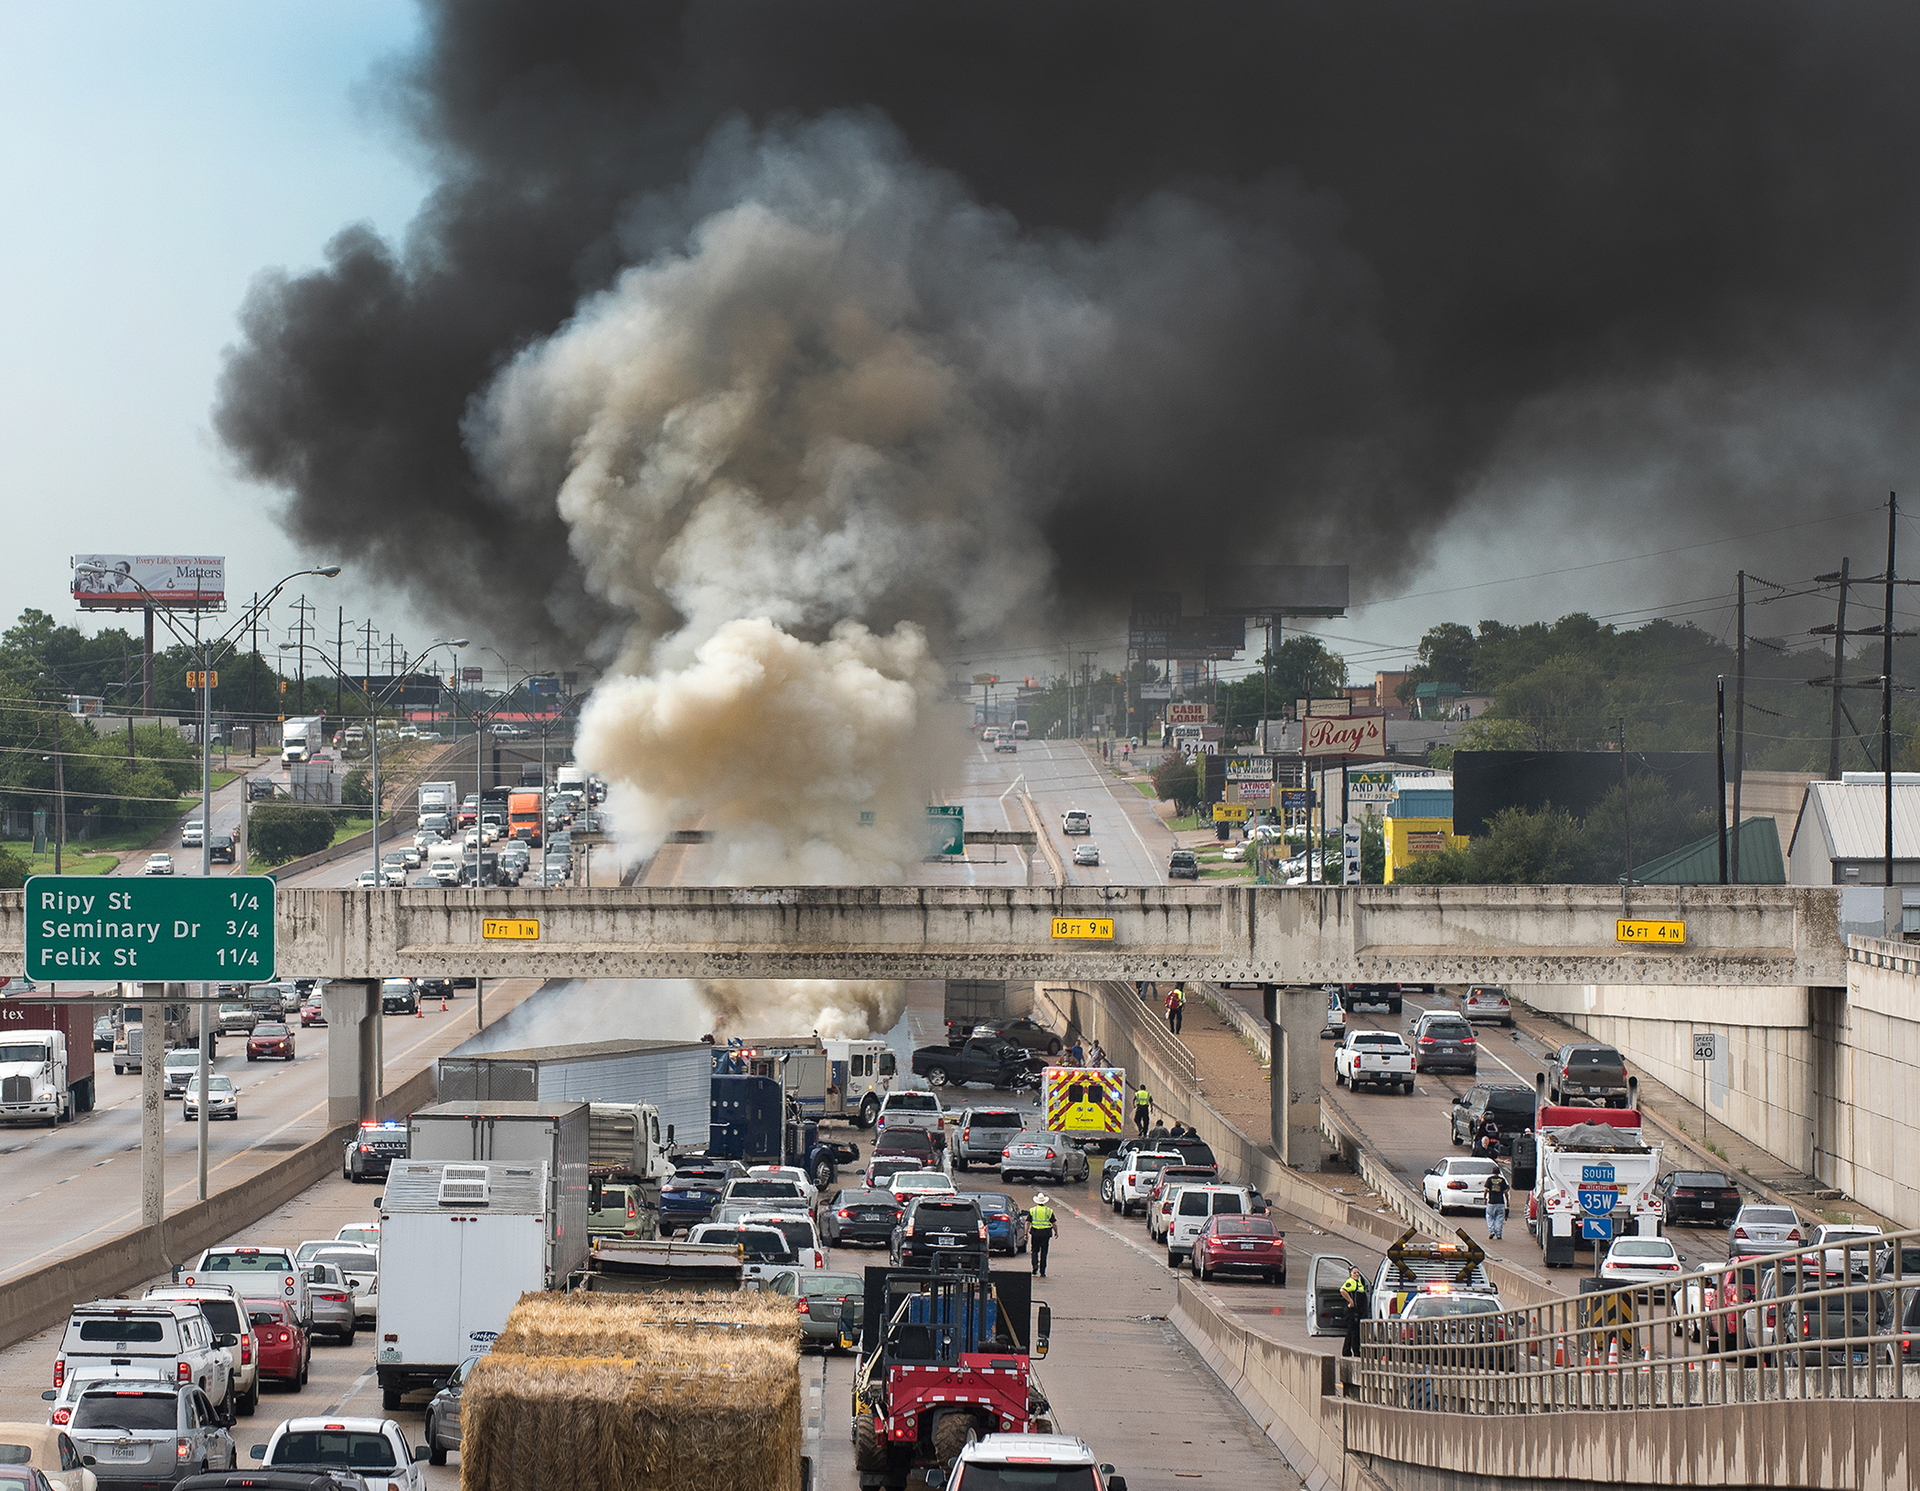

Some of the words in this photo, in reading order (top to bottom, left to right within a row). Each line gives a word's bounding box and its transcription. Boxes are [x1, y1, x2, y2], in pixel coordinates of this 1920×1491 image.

[136, 557, 155, 566] Every
[156, 557, 171, 565] Life,
[173, 558, 192, 566] Every
[176, 566, 222, 578] Matters
[1173, 705, 1202, 714] CASH
[1170, 714, 1204, 722] LOANS
[1309, 720, 1379, 752] Ray's
[1184, 744, 1214, 756] 3440
[1359, 774, 1384, 782] A-1
[1352, 784, 1373, 792] AND
[41, 891, 95, 914] Ripy
[108, 892, 132, 910] St
[230, 892, 259, 910] 1/4
[42, 920, 160, 942] Seminary
[174, 920, 201, 938] Dr
[226, 920, 259, 938] 3/4
[486, 923, 496, 934] 17
[499, 926, 508, 934] FT
[519, 924, 522, 935] 1
[526, 927, 534, 935] IN
[1057, 922, 1068, 934] 18
[1071, 925, 1081, 934] FT
[1090, 922, 1096, 934] 9
[1100, 926, 1108, 934] IN
[1622, 924, 1634, 937] 16
[1637, 928, 1648, 937] FT
[1658, 926, 1666, 938] 4
[1670, 928, 1679, 938] IN
[41, 946, 101, 966] Felix
[114, 948, 138, 966] St
[2, 1008, 24, 1020] tex
[1695, 1048, 1713, 1058] 40
[1584, 1169, 1614, 1178] SOUTH
[1584, 1194, 1612, 1209] 35W
